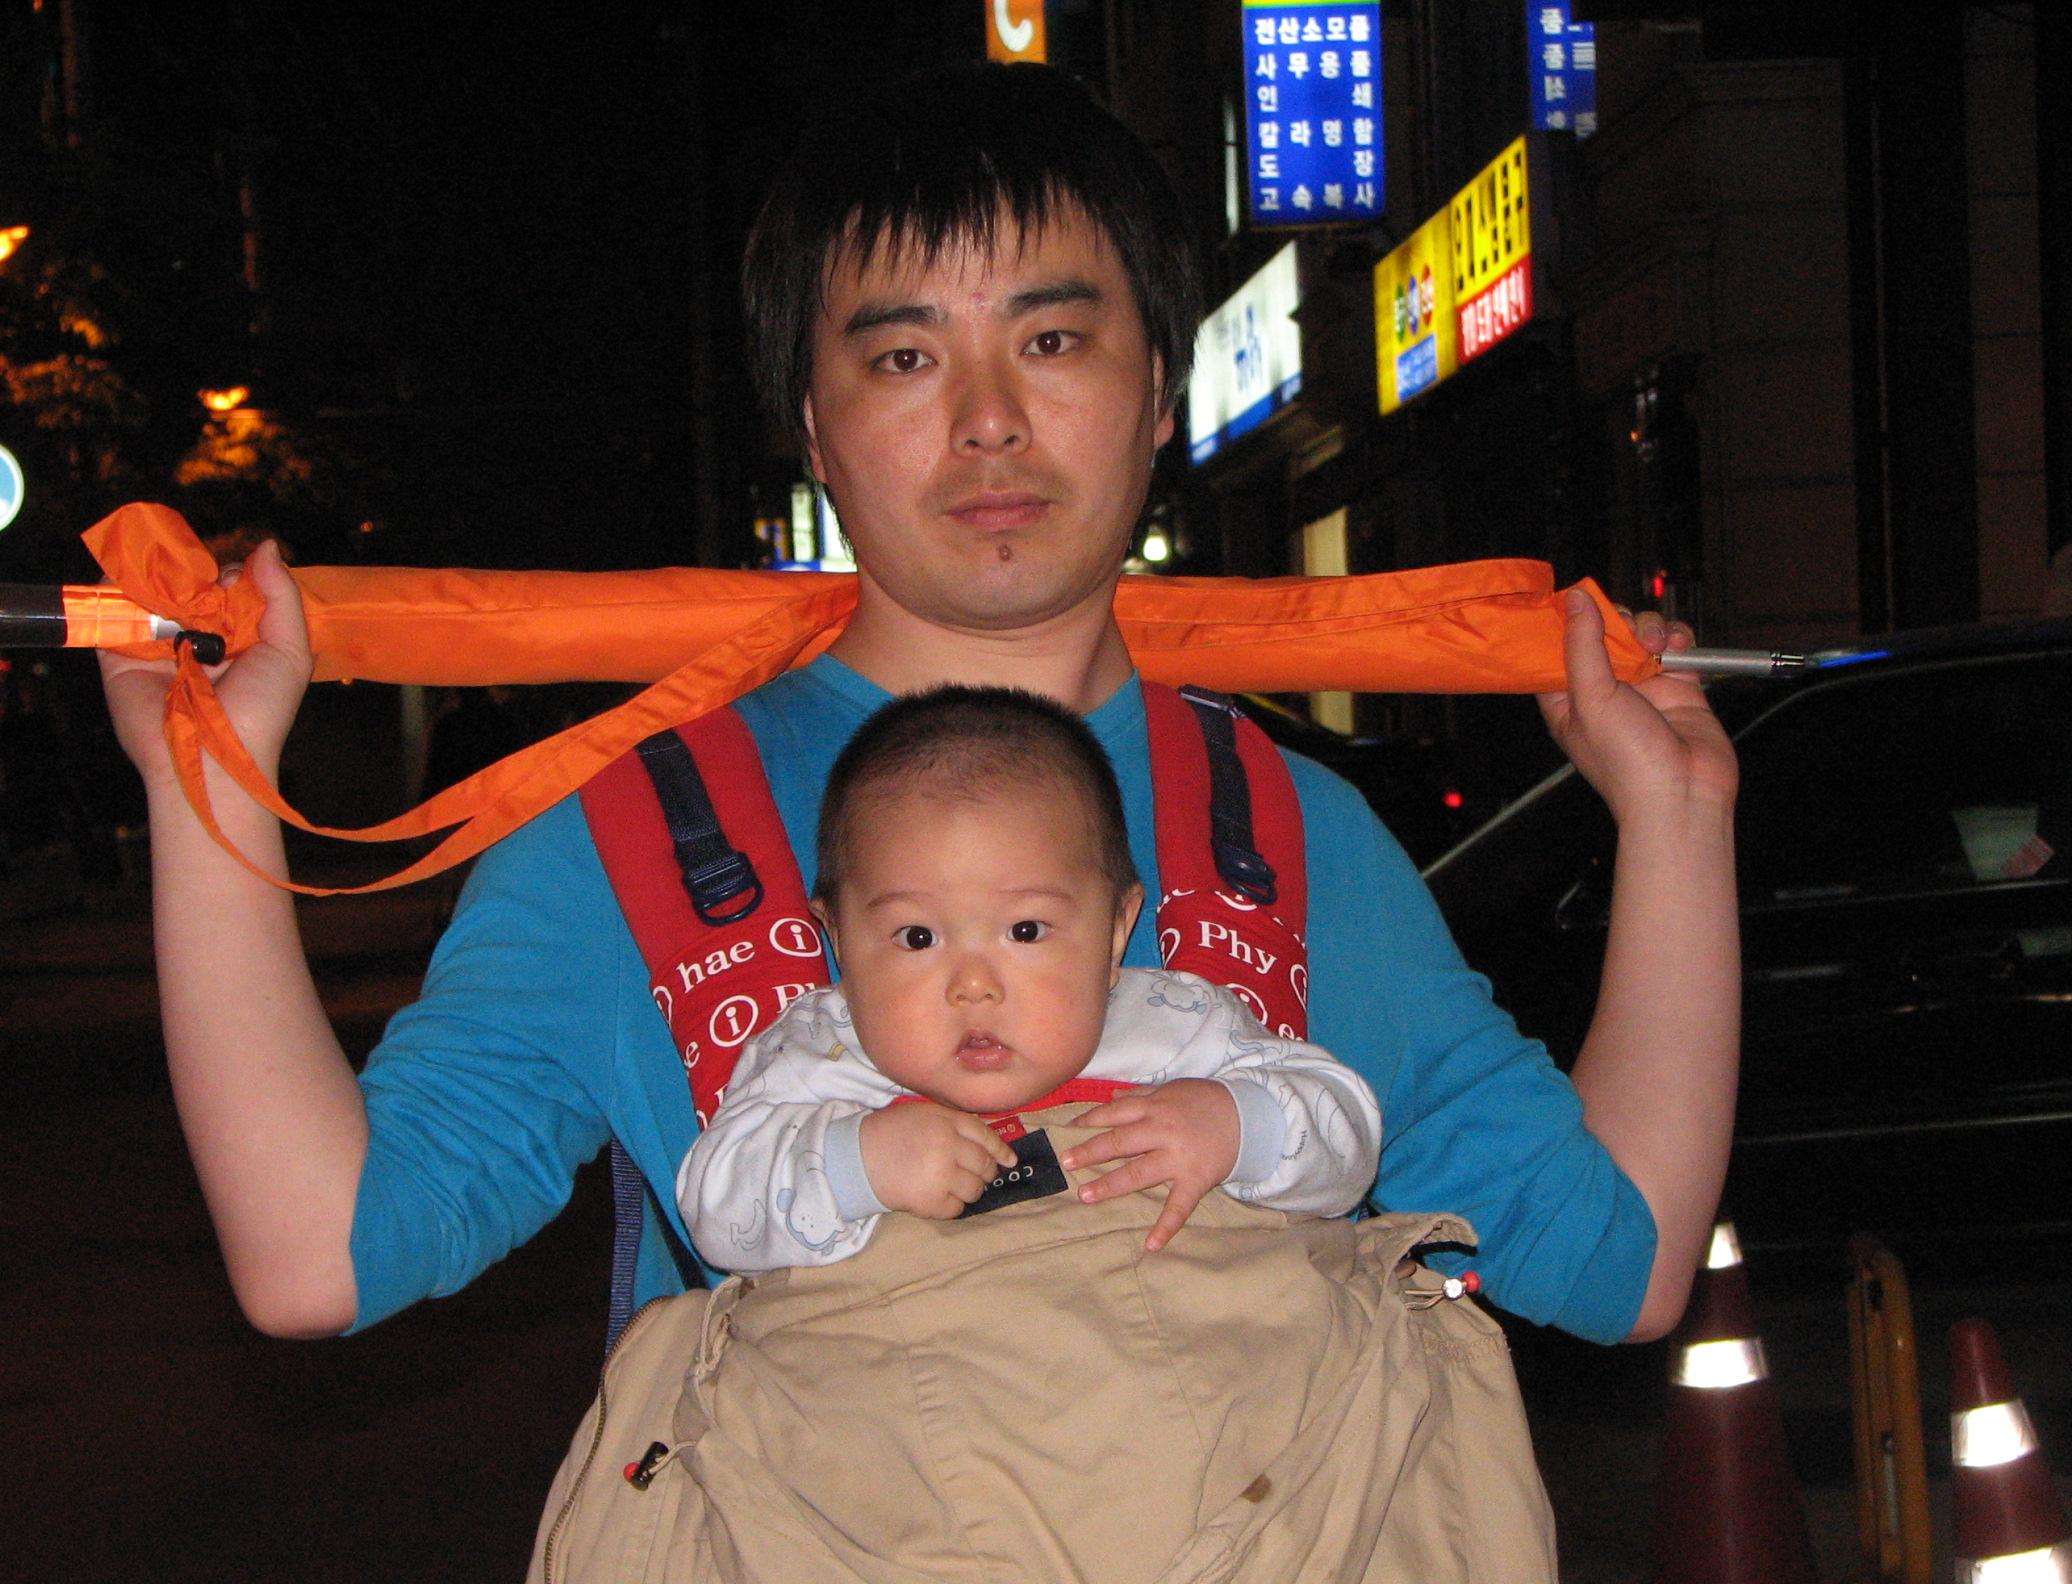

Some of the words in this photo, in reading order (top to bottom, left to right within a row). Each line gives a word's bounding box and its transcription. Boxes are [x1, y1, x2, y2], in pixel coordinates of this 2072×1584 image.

[1255, 15, 1370, 45] 전산소모품
[1256, 50, 1371, 80] 사무용품
[676, 940, 756, 994] hae
[1197, 920, 1278, 975] Phy
